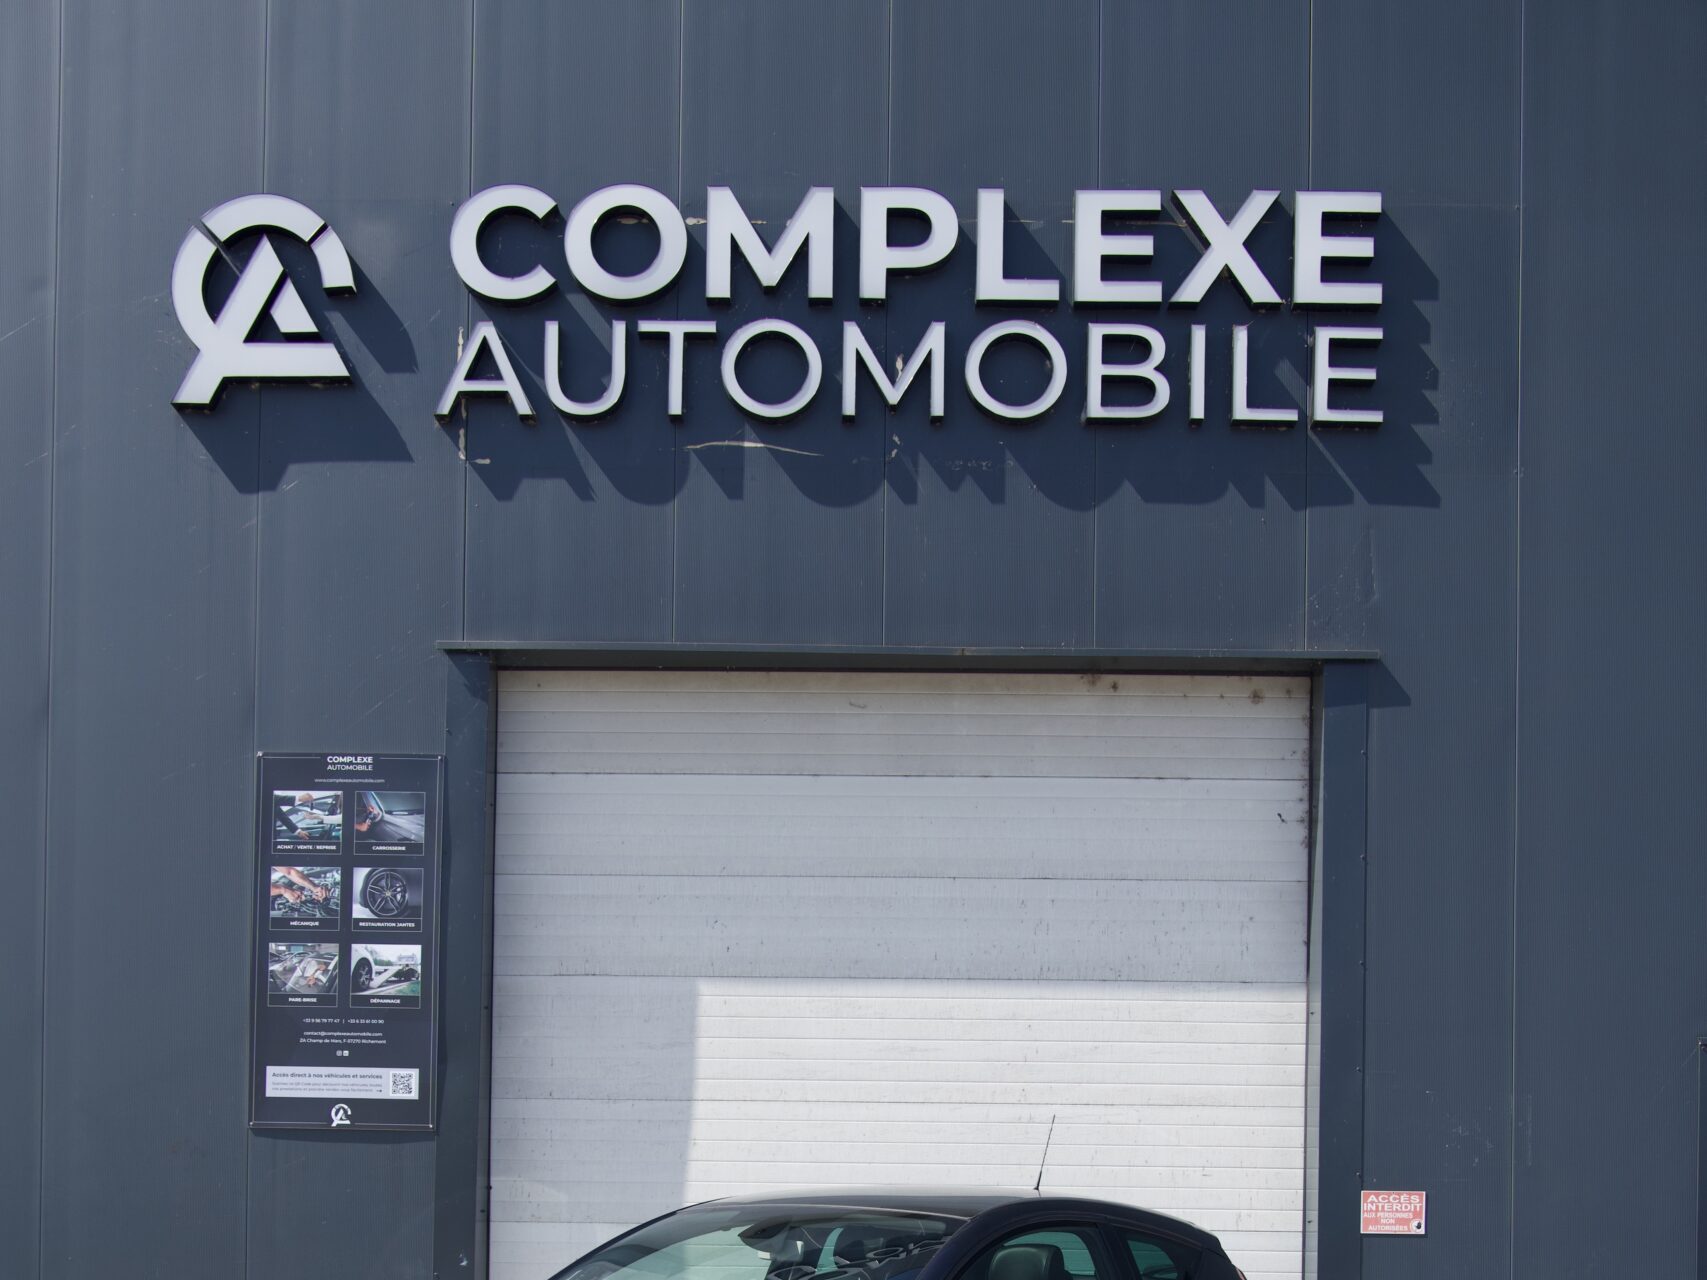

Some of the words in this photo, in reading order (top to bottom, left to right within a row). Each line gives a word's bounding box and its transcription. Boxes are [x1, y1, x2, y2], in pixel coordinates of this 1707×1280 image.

[449, 183, 1383, 307] COMPLEXE
[434, 319, 1384, 426] AUTOMOBILE
[1363, 1203, 1422, 1211] INTERDIT
[1367, 1194, 1420, 1203] ACCÈS
